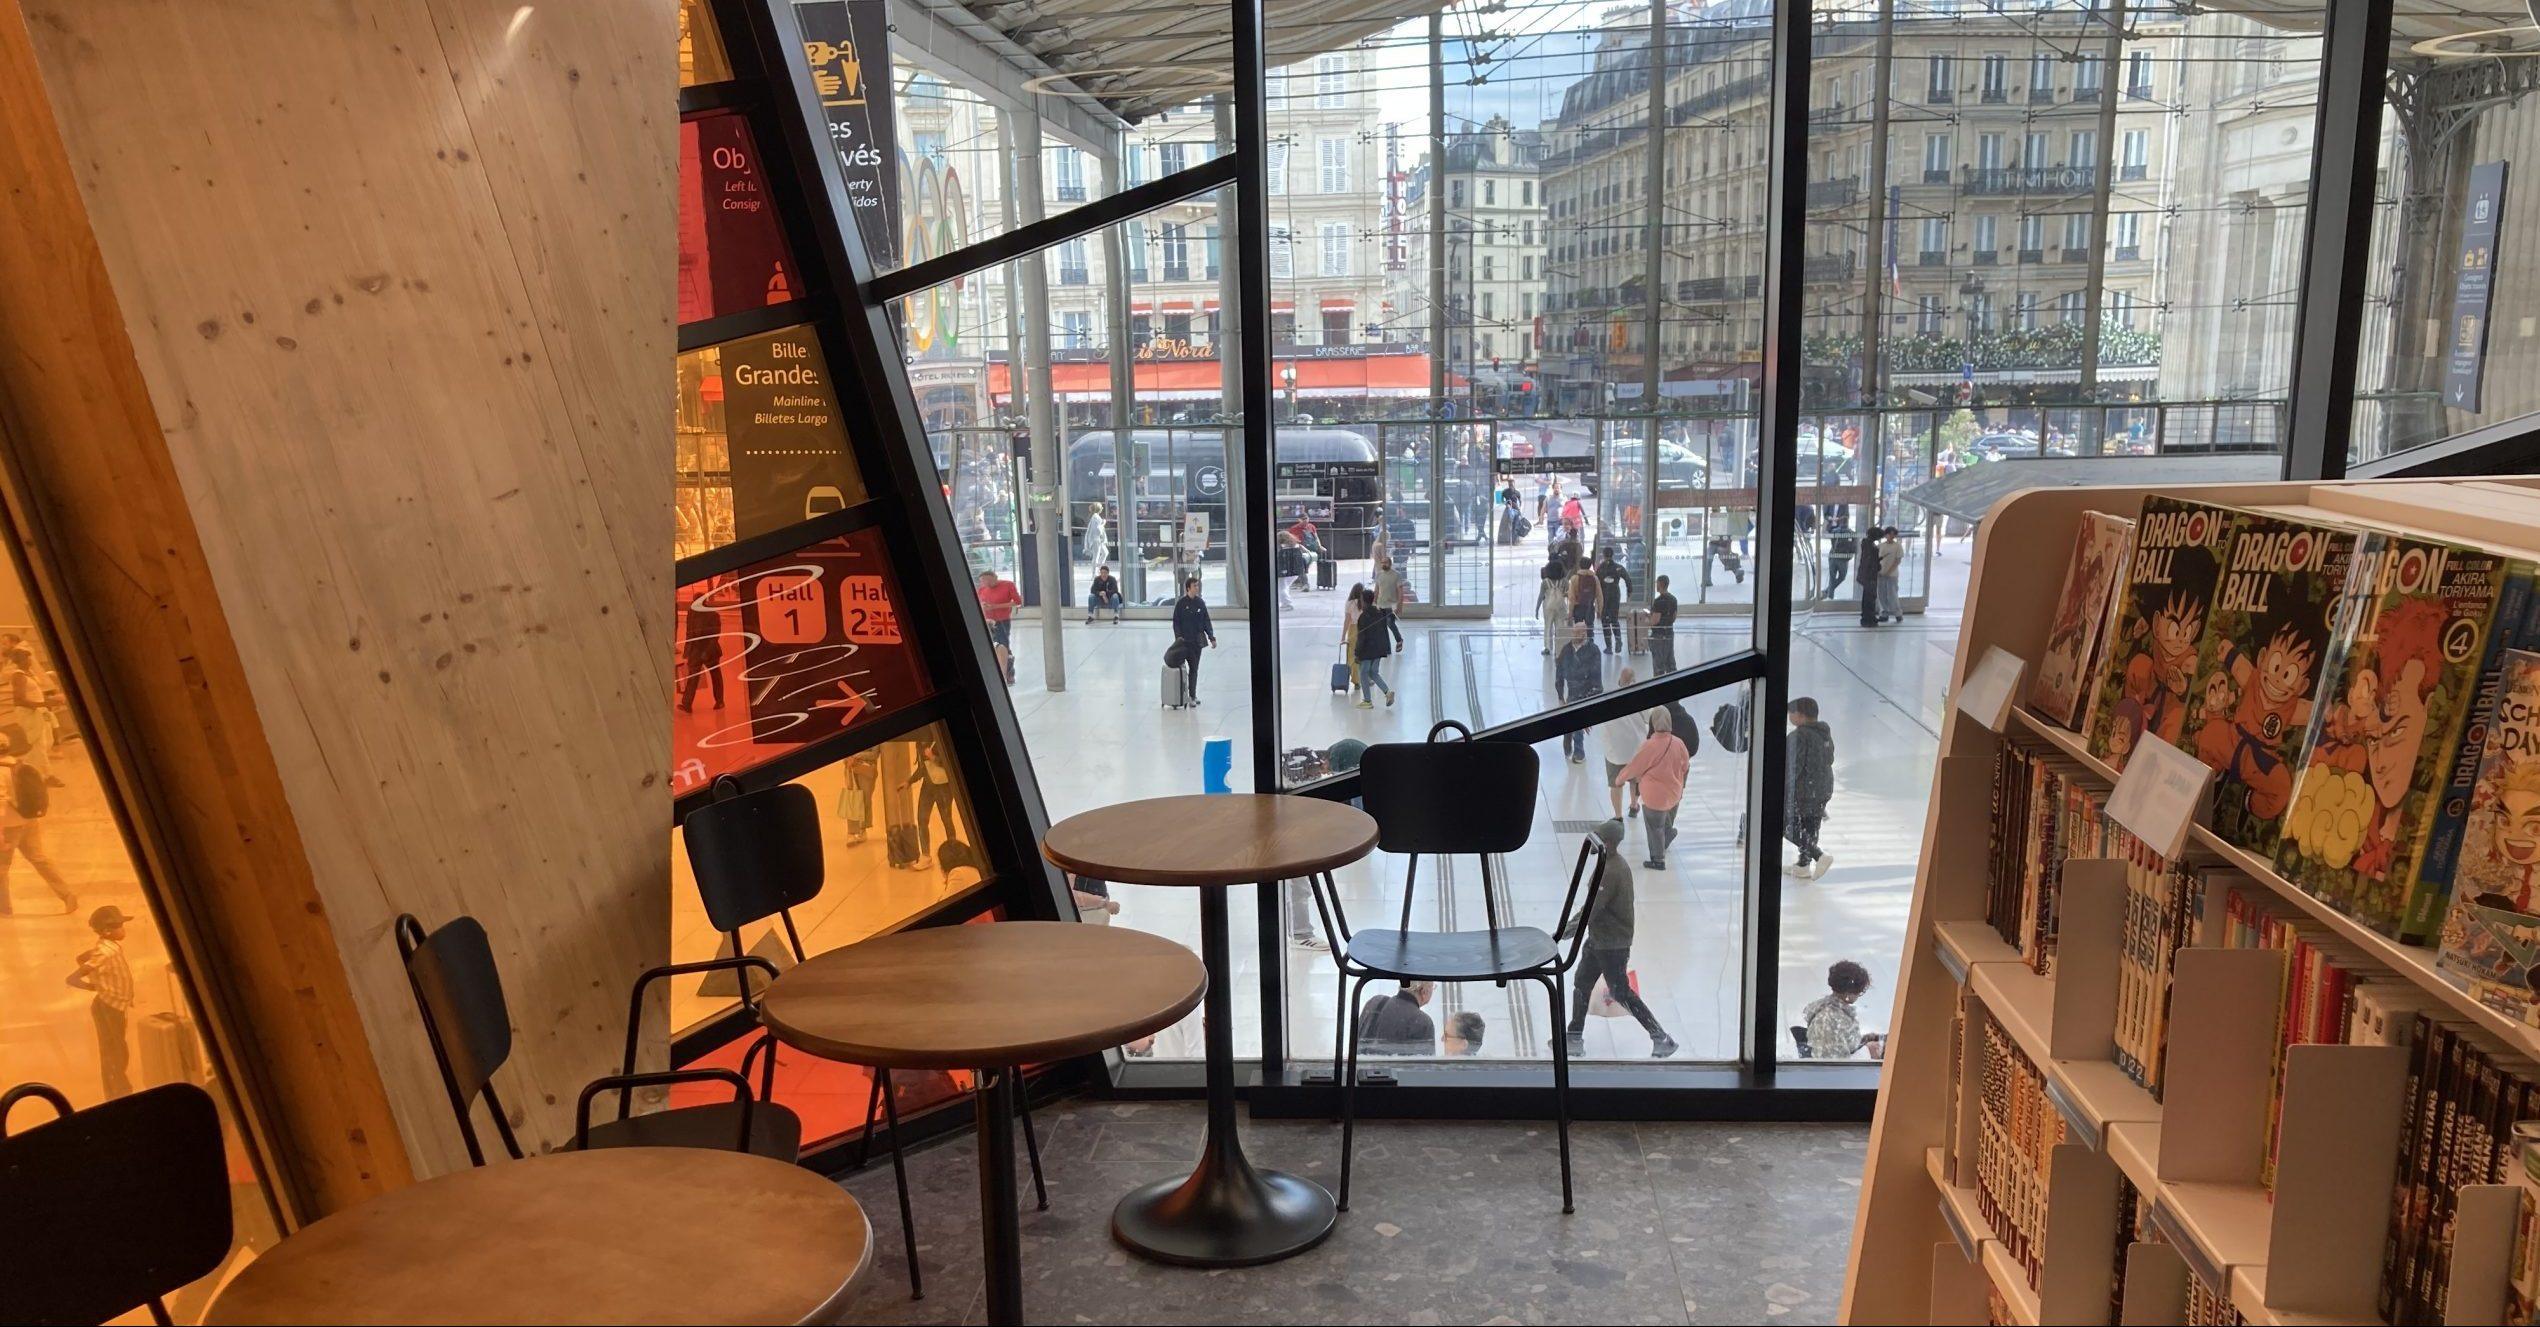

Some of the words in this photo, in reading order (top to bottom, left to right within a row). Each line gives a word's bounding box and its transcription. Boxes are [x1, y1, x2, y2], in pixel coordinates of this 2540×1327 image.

[840, 143, 882, 167] vés
[725, 180, 745, 192] Left
[849, 179, 873, 192] erty
[850, 196, 878, 208] idos
[772, 342, 810, 359] Bille
[773, 395, 820, 407] Mainline
[754, 413, 795, 424] Billetes
[797, 413, 828, 427] Larga
[2140, 510, 2224, 548] DRAGON
[2232, 531, 2332, 573] DRAGON
[2132, 549, 2175, 584] BALL
[2348, 548, 2449, 596] DRAGON
[2452, 573, 2486, 585] AKIRA
[768, 582, 814, 601] Hall
[851, 582, 888, 601] Hal
[2221, 573, 2272, 613] BALL
[2440, 585, 2494, 598] TORIYAMA
[784, 608, 800, 636] 1
[850, 608, 869, 636] 2
[2450, 631, 2468, 655] 4
[2499, 698, 2540, 727] SCH
[2453, 711, 2492, 787] DRAGON
[2498, 727, 2540, 757] DAY
[2424, 1089, 2438, 1139] TITANS
[2442, 1100, 2456, 1151] TITANS
[2498, 1144, 2510, 1185] TANS
